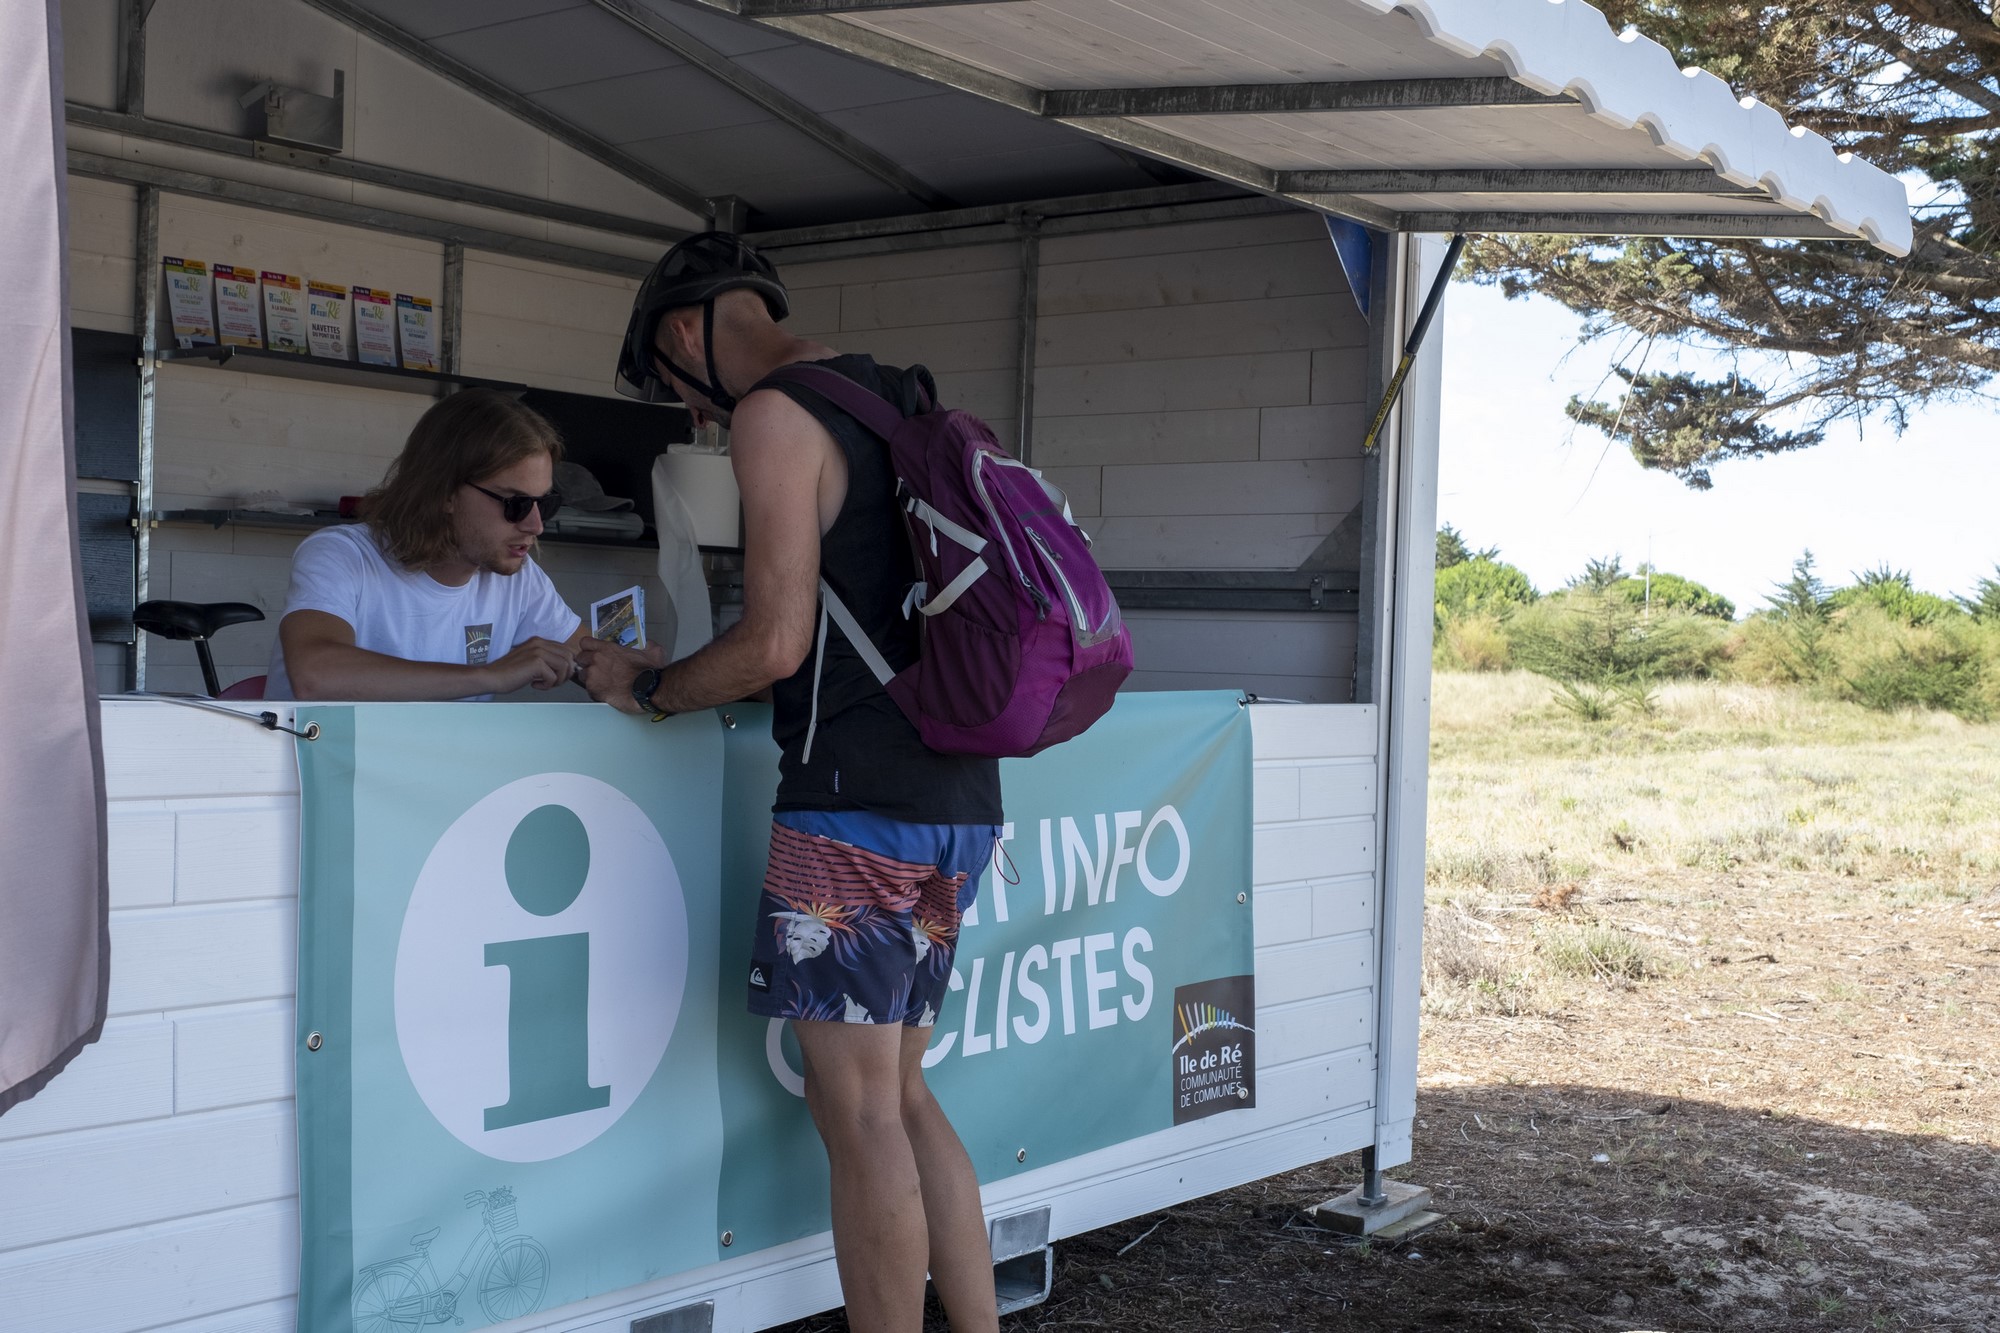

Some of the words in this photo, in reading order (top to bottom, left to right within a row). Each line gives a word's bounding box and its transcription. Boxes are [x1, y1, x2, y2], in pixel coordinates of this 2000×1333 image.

[312, 323, 340, 334] NAVETTES
[1040, 805, 1190, 915] INFO
[1180, 1055, 1197, 1075] Ile
[1200, 1050, 1217, 1070] de
[1221, 1043, 1242, 1065] Ré
[1180, 1063, 1242, 1091] COMMUNAUTÉ
[1181, 1093, 1191, 1108] DE
